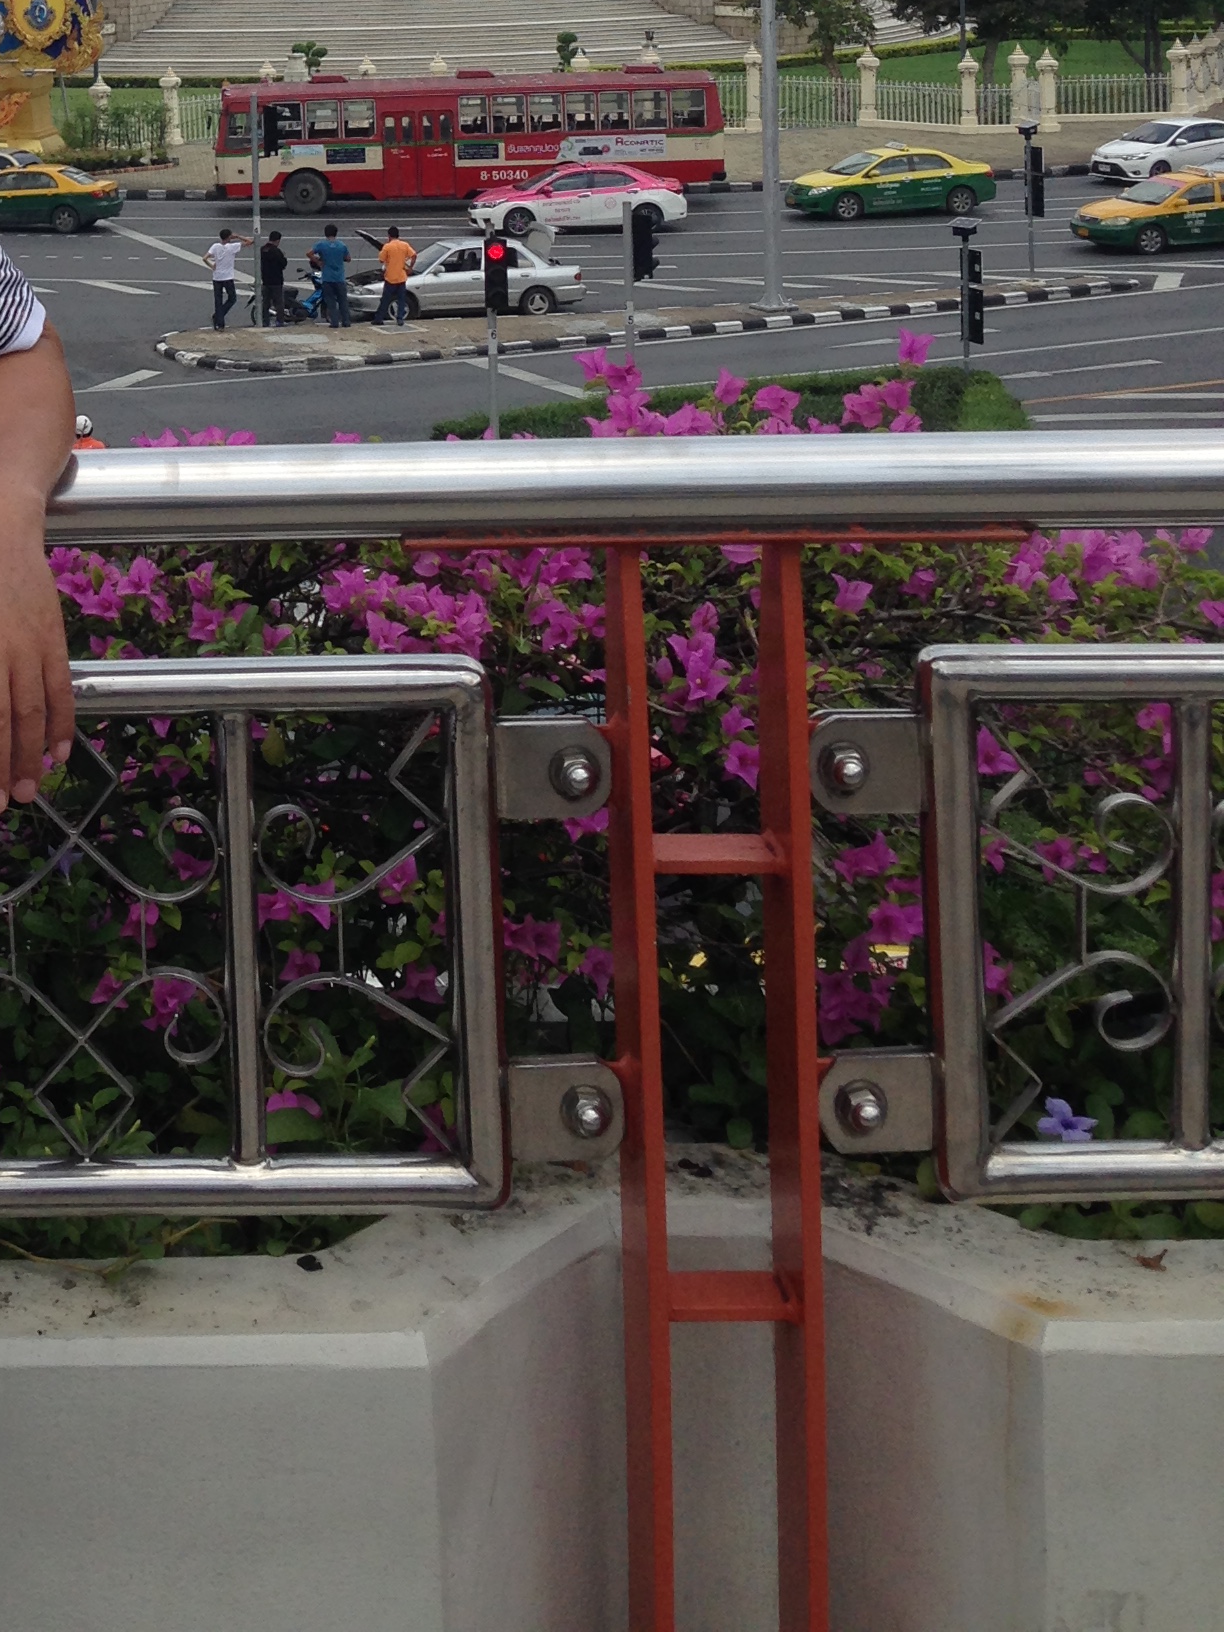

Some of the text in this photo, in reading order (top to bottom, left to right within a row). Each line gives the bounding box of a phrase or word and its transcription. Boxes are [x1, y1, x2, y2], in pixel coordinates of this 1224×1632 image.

[480, 169, 529, 181] 8-50340
[627, 315, 634, 325] 5
[490, 329, 497, 340] 6
